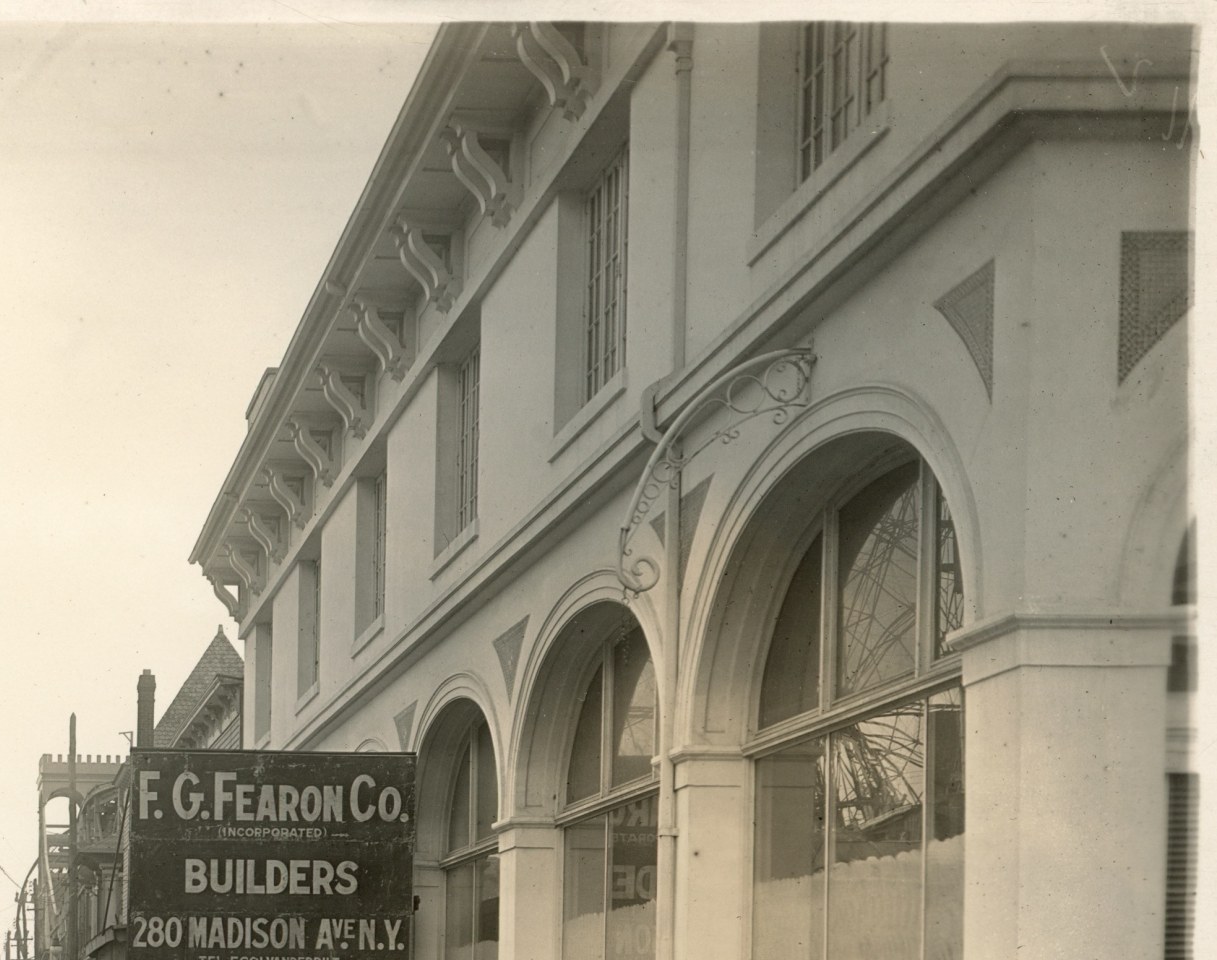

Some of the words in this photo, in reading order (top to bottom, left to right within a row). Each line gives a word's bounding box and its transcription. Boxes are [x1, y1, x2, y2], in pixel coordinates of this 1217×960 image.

[184, 858, 359, 895] BUILDERS
[134, 916, 183, 948] 280
[188, 916, 305, 949] MADISON
